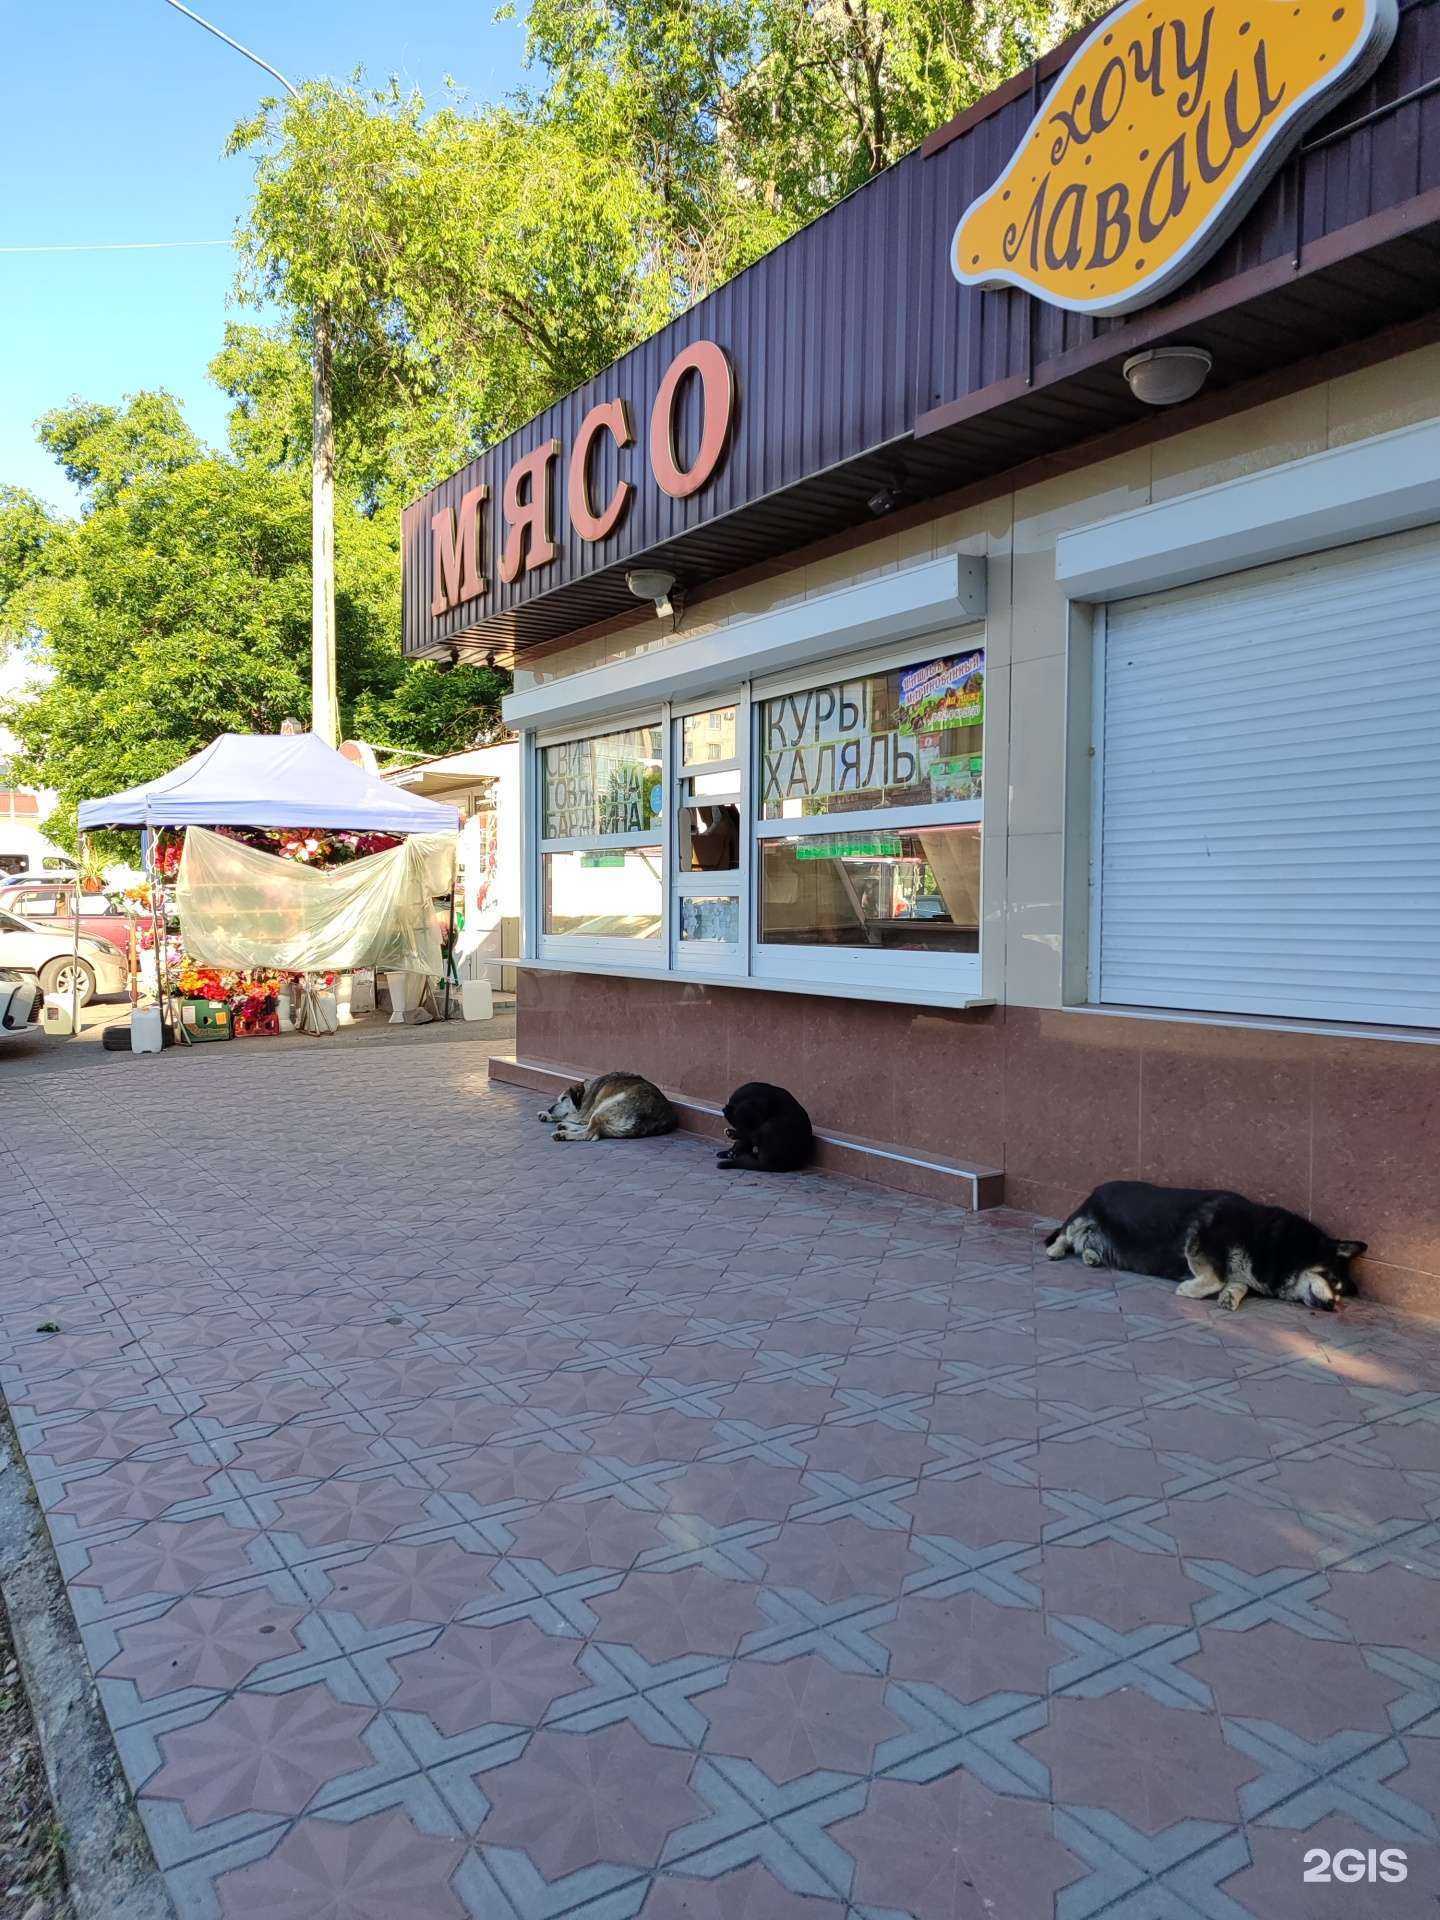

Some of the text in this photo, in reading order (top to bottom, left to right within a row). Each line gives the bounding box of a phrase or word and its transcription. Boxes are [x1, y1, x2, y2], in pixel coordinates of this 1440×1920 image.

[431, 340, 735, 618] МЯСО
[768, 681, 867, 751] КУРЫ
[763, 731, 917, 800] ХАЛЯЛЬ
